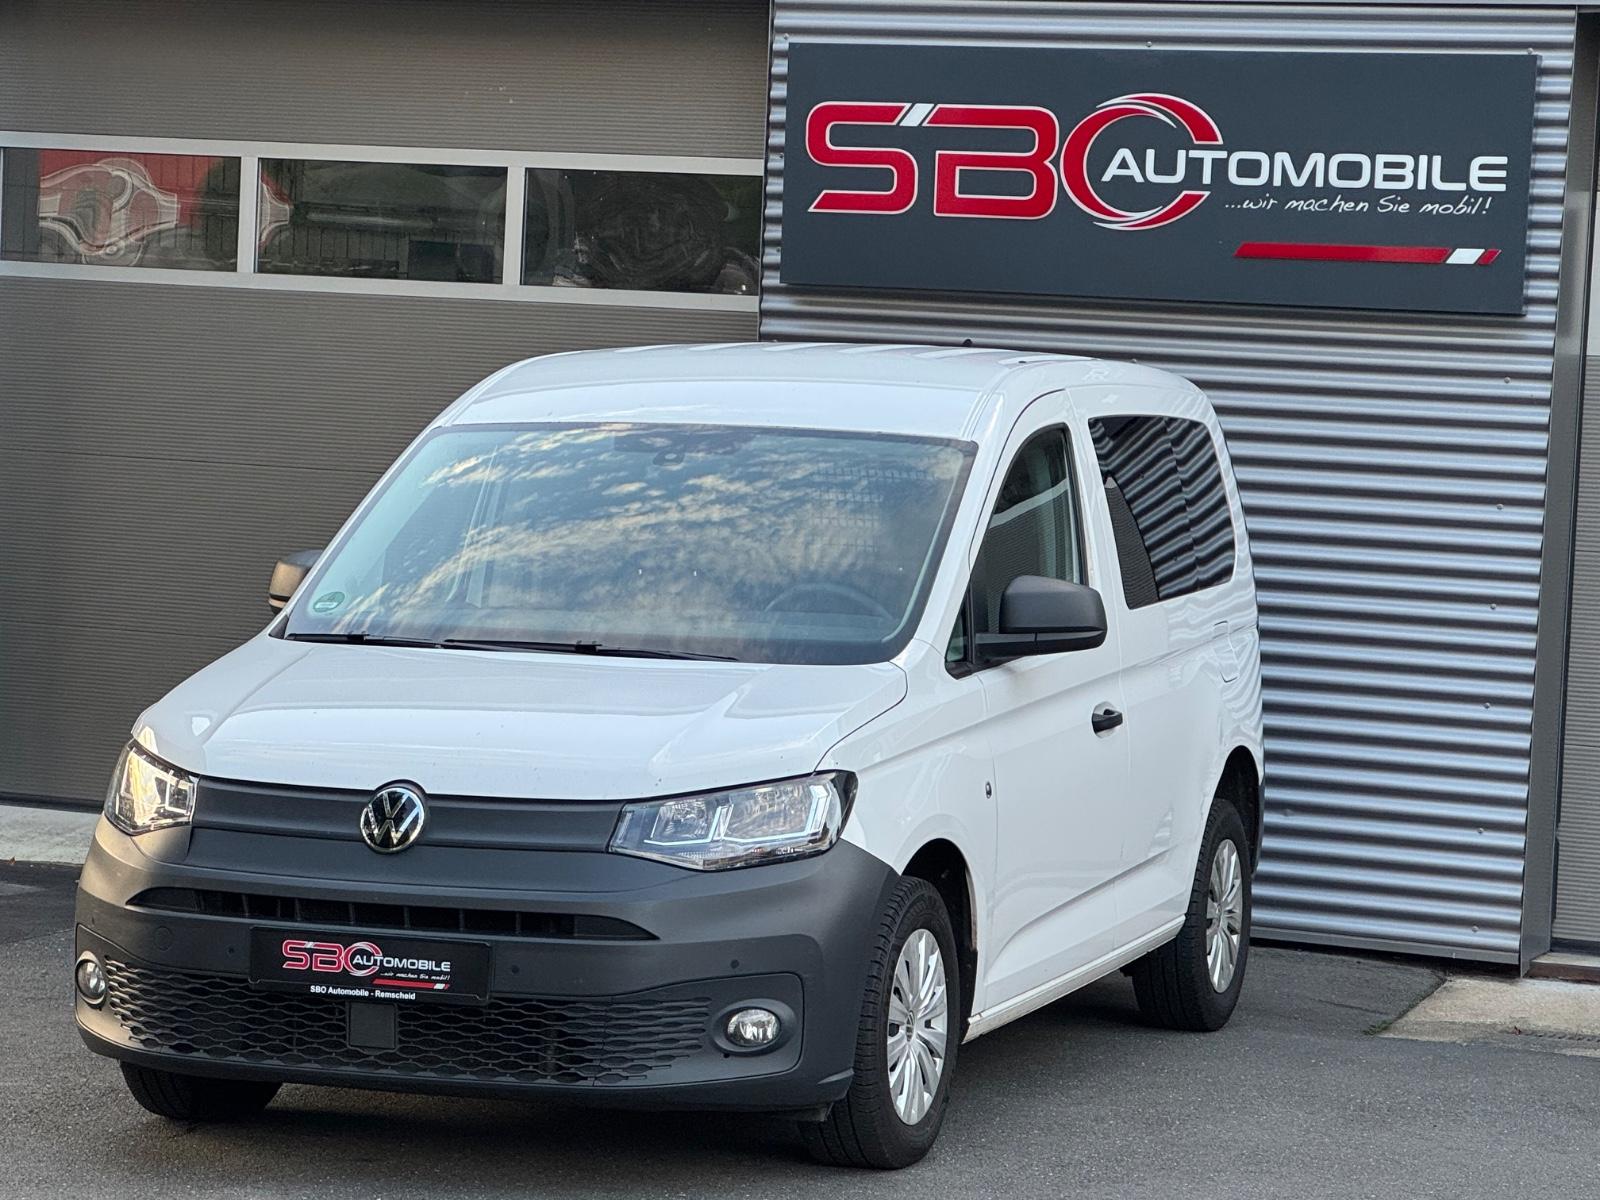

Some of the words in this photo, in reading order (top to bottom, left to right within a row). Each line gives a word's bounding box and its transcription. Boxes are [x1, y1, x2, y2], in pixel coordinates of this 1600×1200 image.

[1101, 146, 1508, 194] AUTOMOBILE
[1283, 193, 1370, 213] machen
[1376, 194, 1411, 213] Sie
[1418, 194, 1493, 215] mobil!
[352, 954, 451, 972] AUTOMOBILE
[310, 985, 327, 994] SBO
[327, 986, 369, 997] Automobile
[374, 989, 416, 1000] Remscheid
